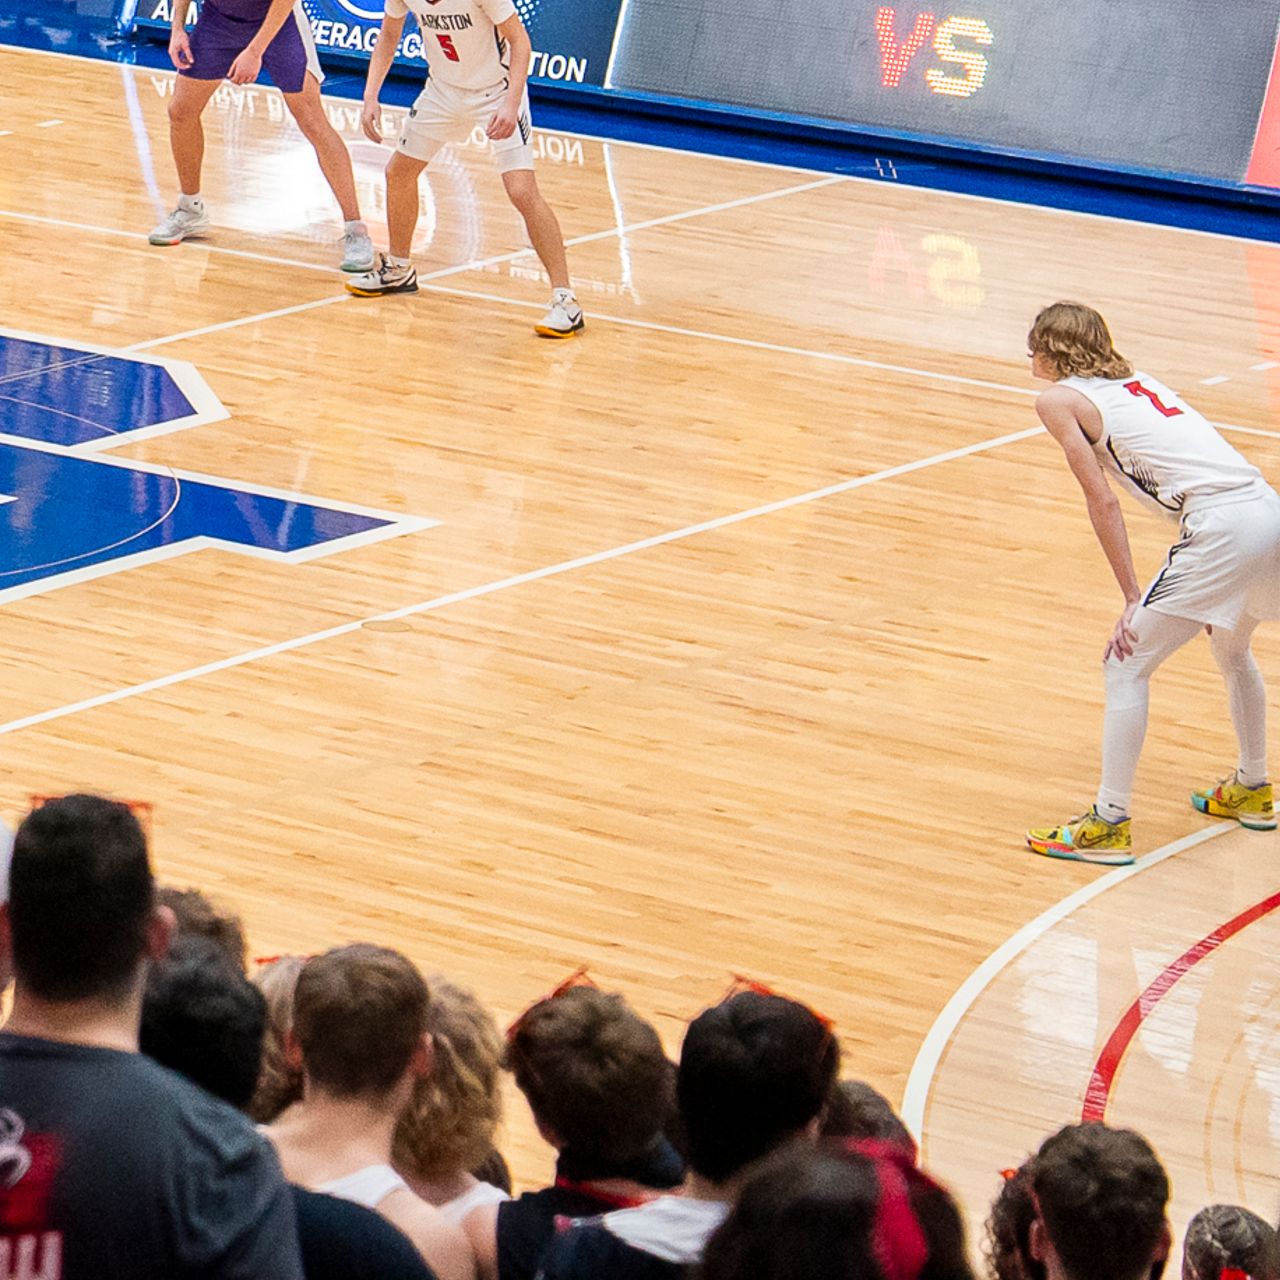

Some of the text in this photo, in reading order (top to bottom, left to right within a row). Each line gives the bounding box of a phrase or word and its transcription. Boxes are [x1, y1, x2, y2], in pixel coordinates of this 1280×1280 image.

[421, 13, 474, 31] ARKSTON
[435, 33, 460, 62] 5
[875, 6, 995, 98] VS
